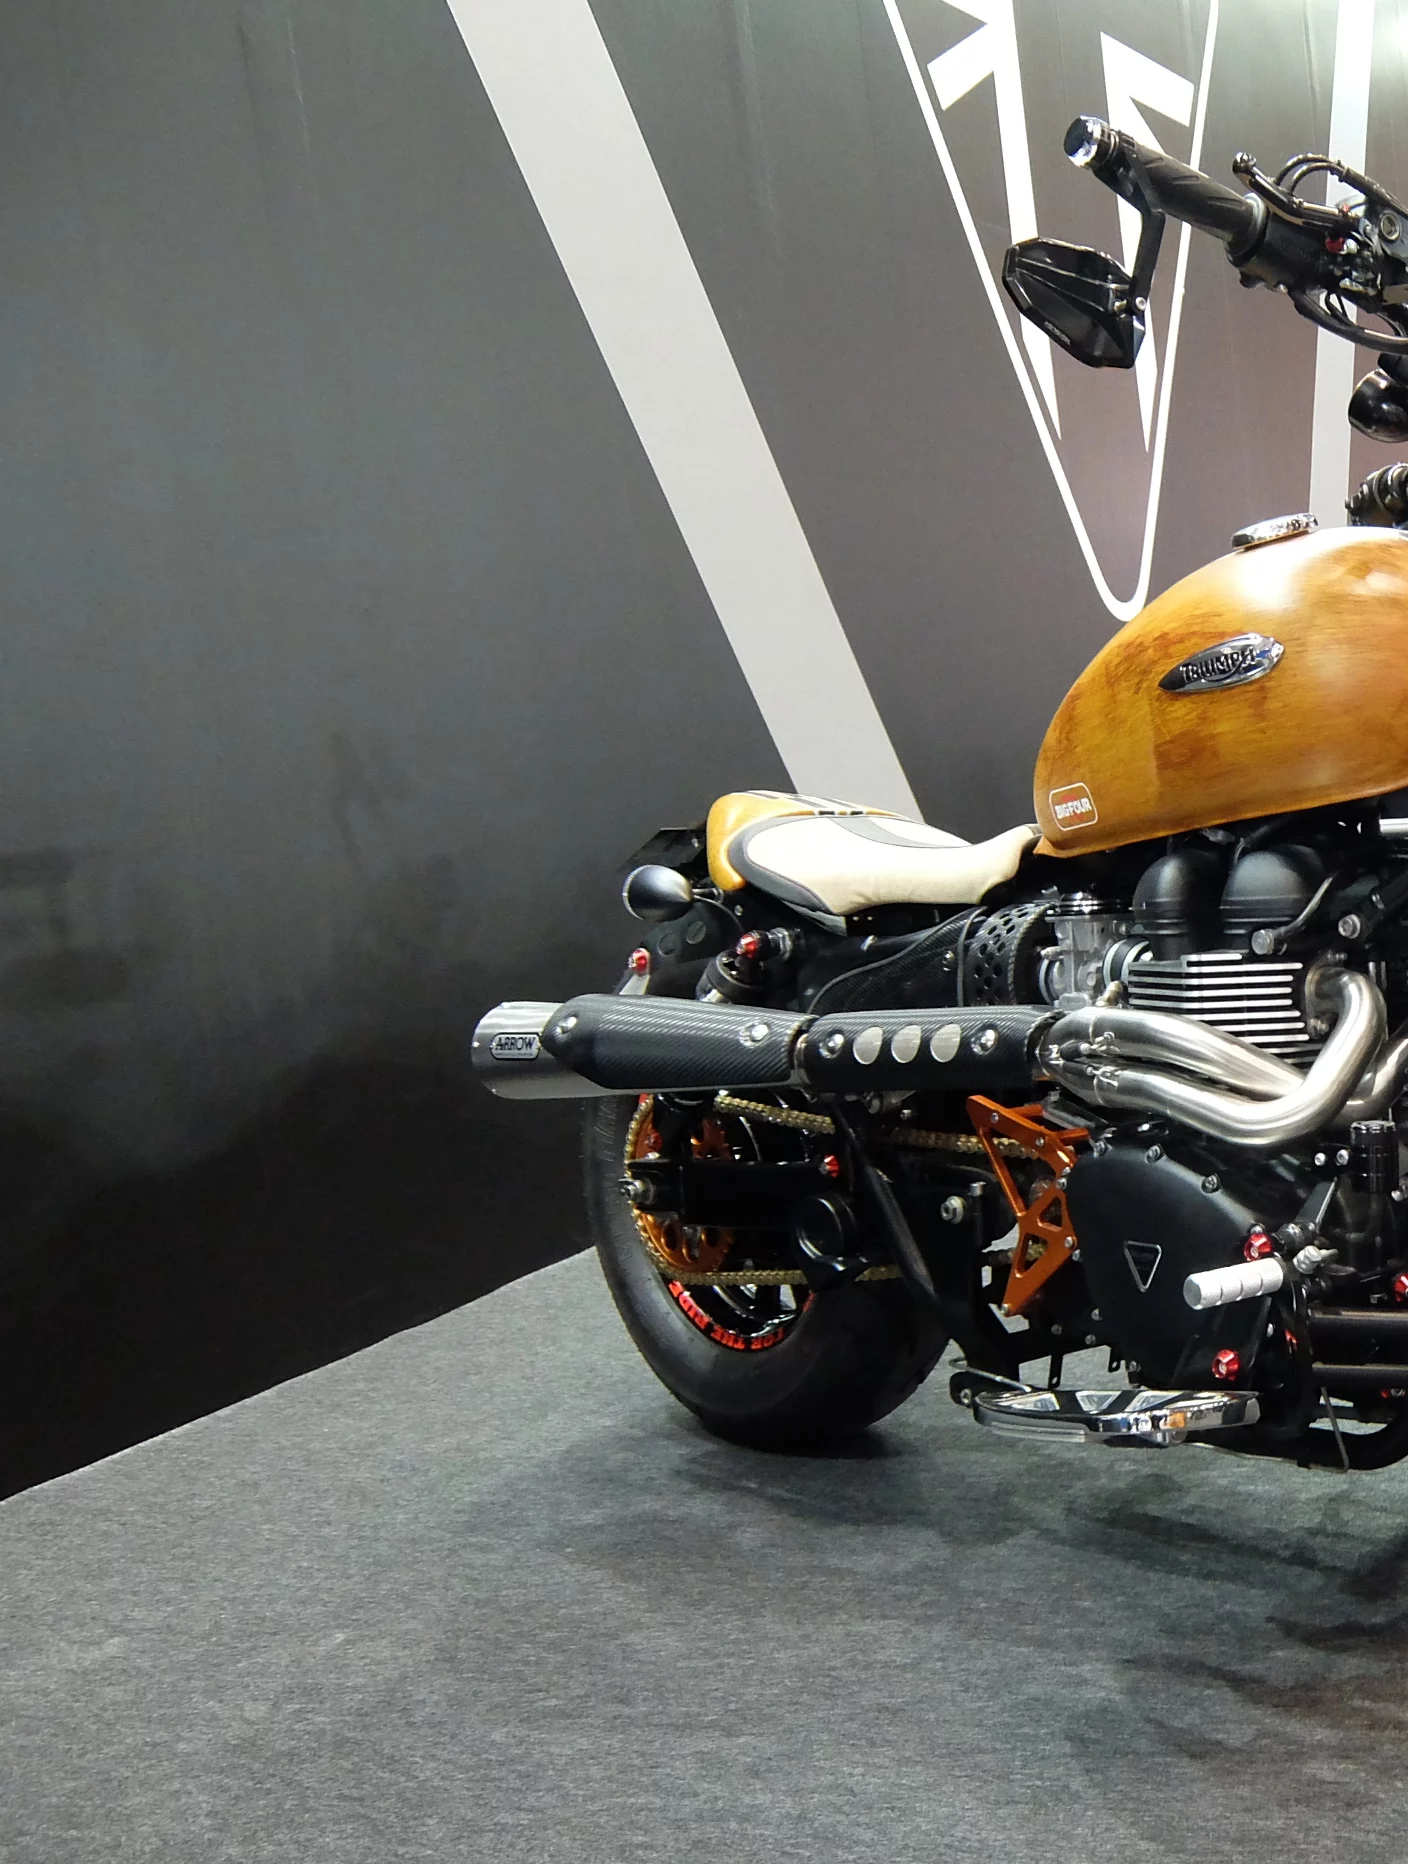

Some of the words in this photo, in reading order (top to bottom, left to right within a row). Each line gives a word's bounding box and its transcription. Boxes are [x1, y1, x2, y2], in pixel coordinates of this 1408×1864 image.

[1180, 645, 1257, 684] TRIUMPH
[494, 1036, 536, 1051] ARROW
[710, 1323, 746, 1351] THE
